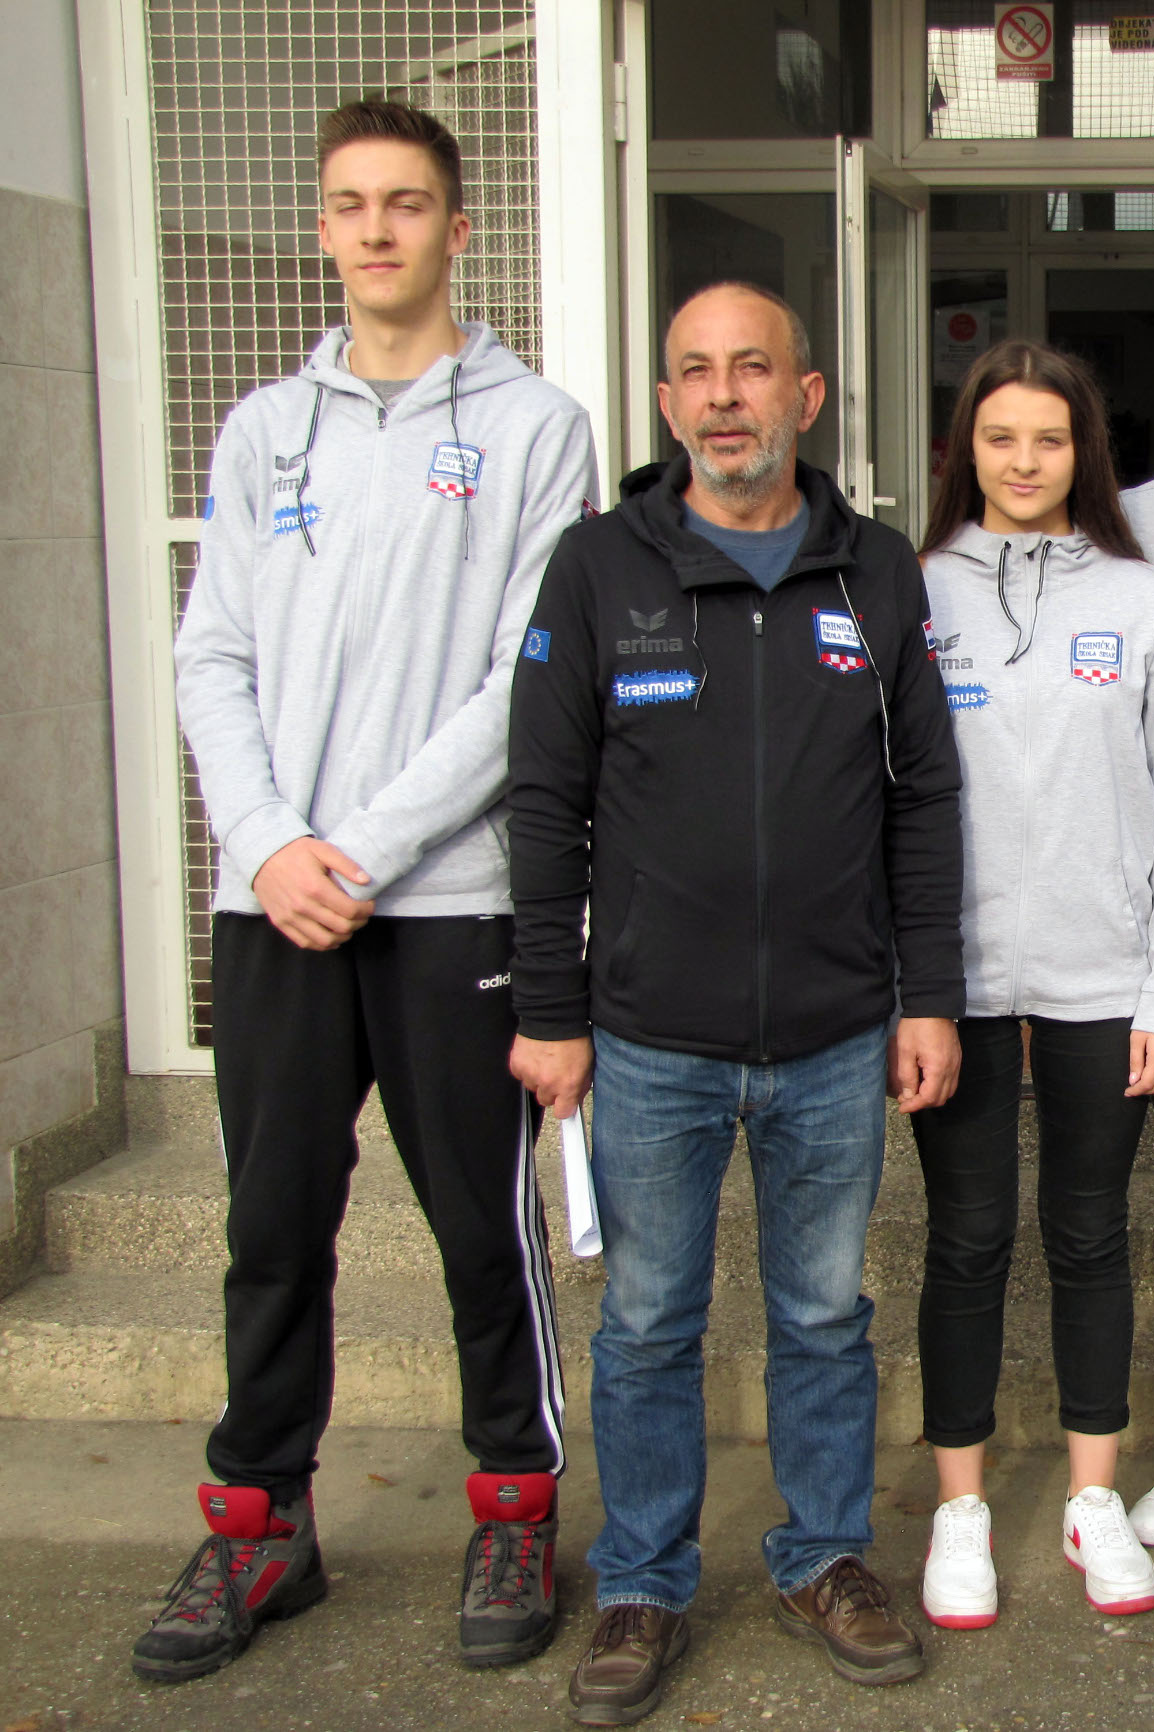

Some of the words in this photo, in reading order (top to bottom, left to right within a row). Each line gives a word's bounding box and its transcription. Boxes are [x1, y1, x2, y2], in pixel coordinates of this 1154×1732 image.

[1111, 30, 1123, 38] JE
[1128, 29, 1149, 38] POD
[616, 635, 684, 655] erima
[616, 680, 696, 698] Erasmus+
[479, 971, 511, 989] adid
